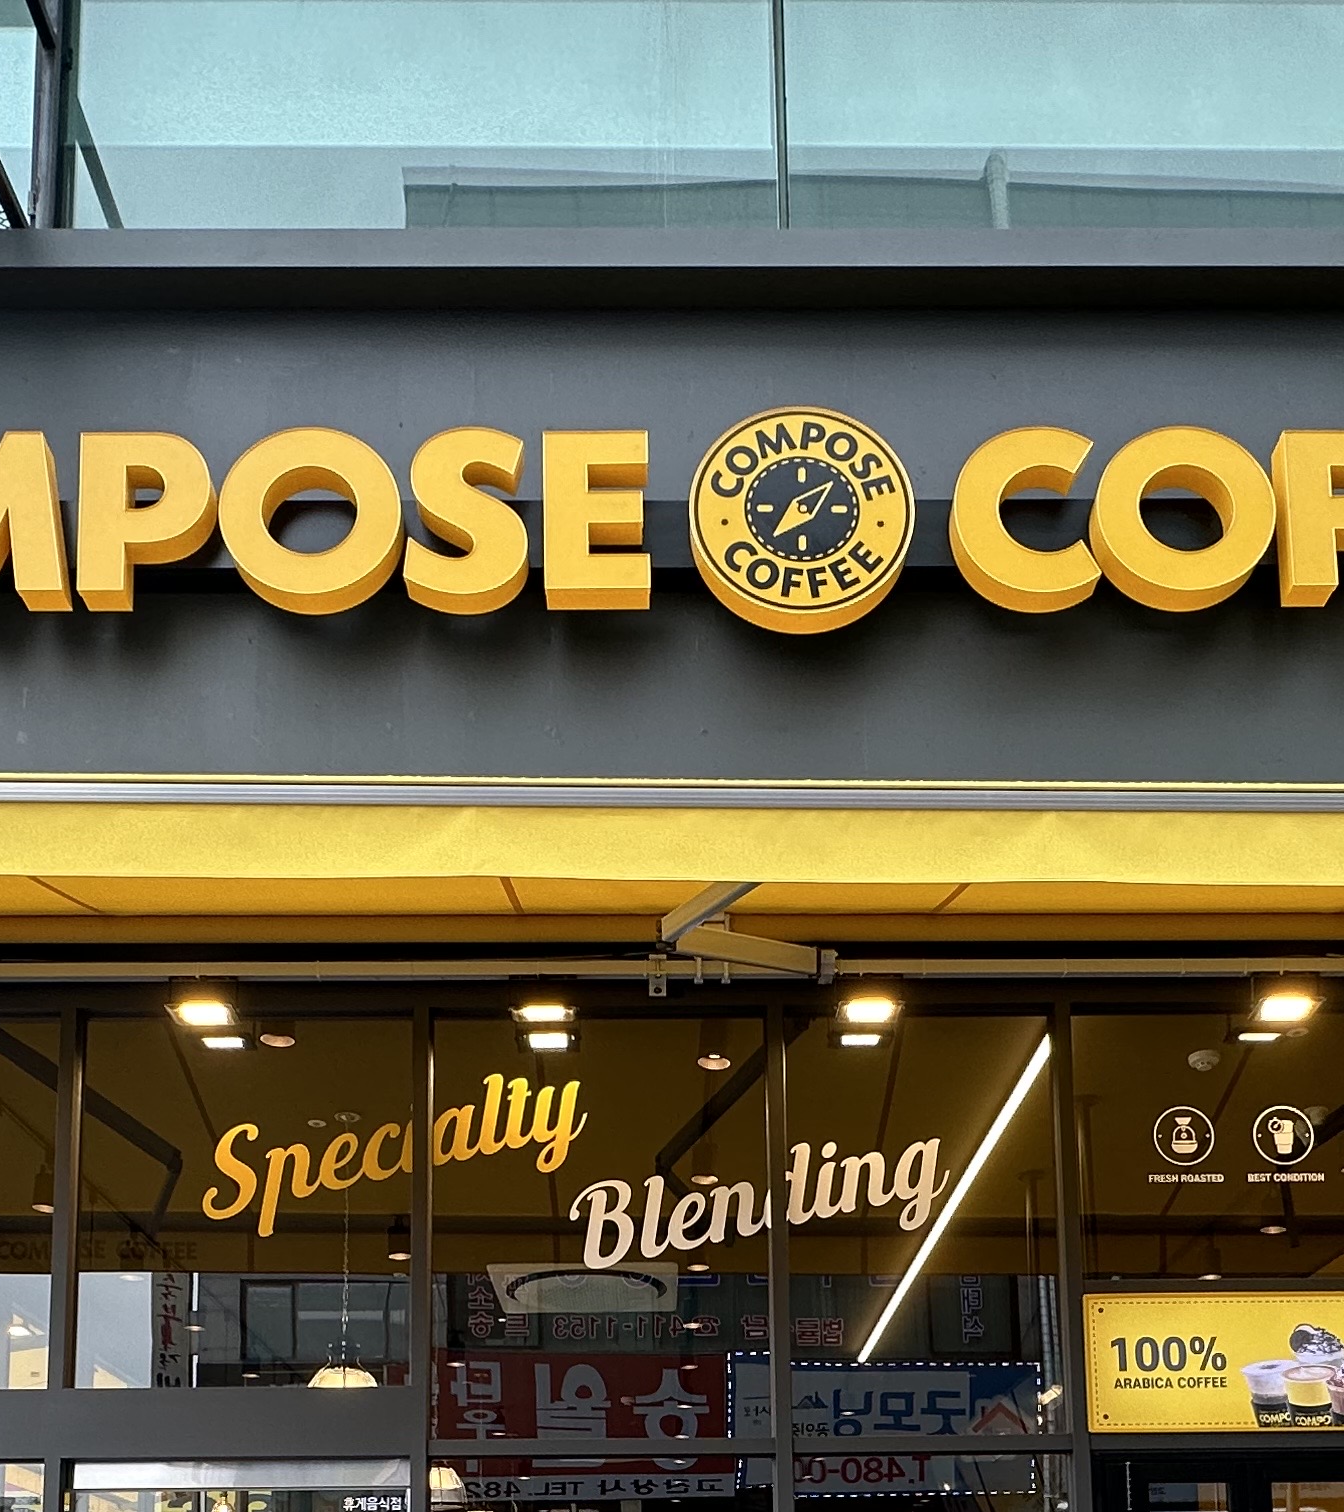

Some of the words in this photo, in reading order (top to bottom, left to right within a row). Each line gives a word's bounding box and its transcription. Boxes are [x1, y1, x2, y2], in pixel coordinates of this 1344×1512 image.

[711, 421, 895, 501] COMPOSE
[725, 541, 883, 598] COFFEE
[203, 1074, 587, 1237] Specialty
[1149, 1173, 1178, 1183] FRESH
[1181, 1173, 1224, 1183] ROASTED
[1247, 1173, 1271, 1182] BEST
[1273, 1172, 1325, 1182] CONDITION
[570, 1137, 950, 1270] Blending
[1110, 1336, 1227, 1372] 100%
[1114, 1376, 1174, 1389] ARABICA
[1177, 1376, 1228, 1388] COFFEE
[343, 1496, 402, 1512] 휴게음식점
